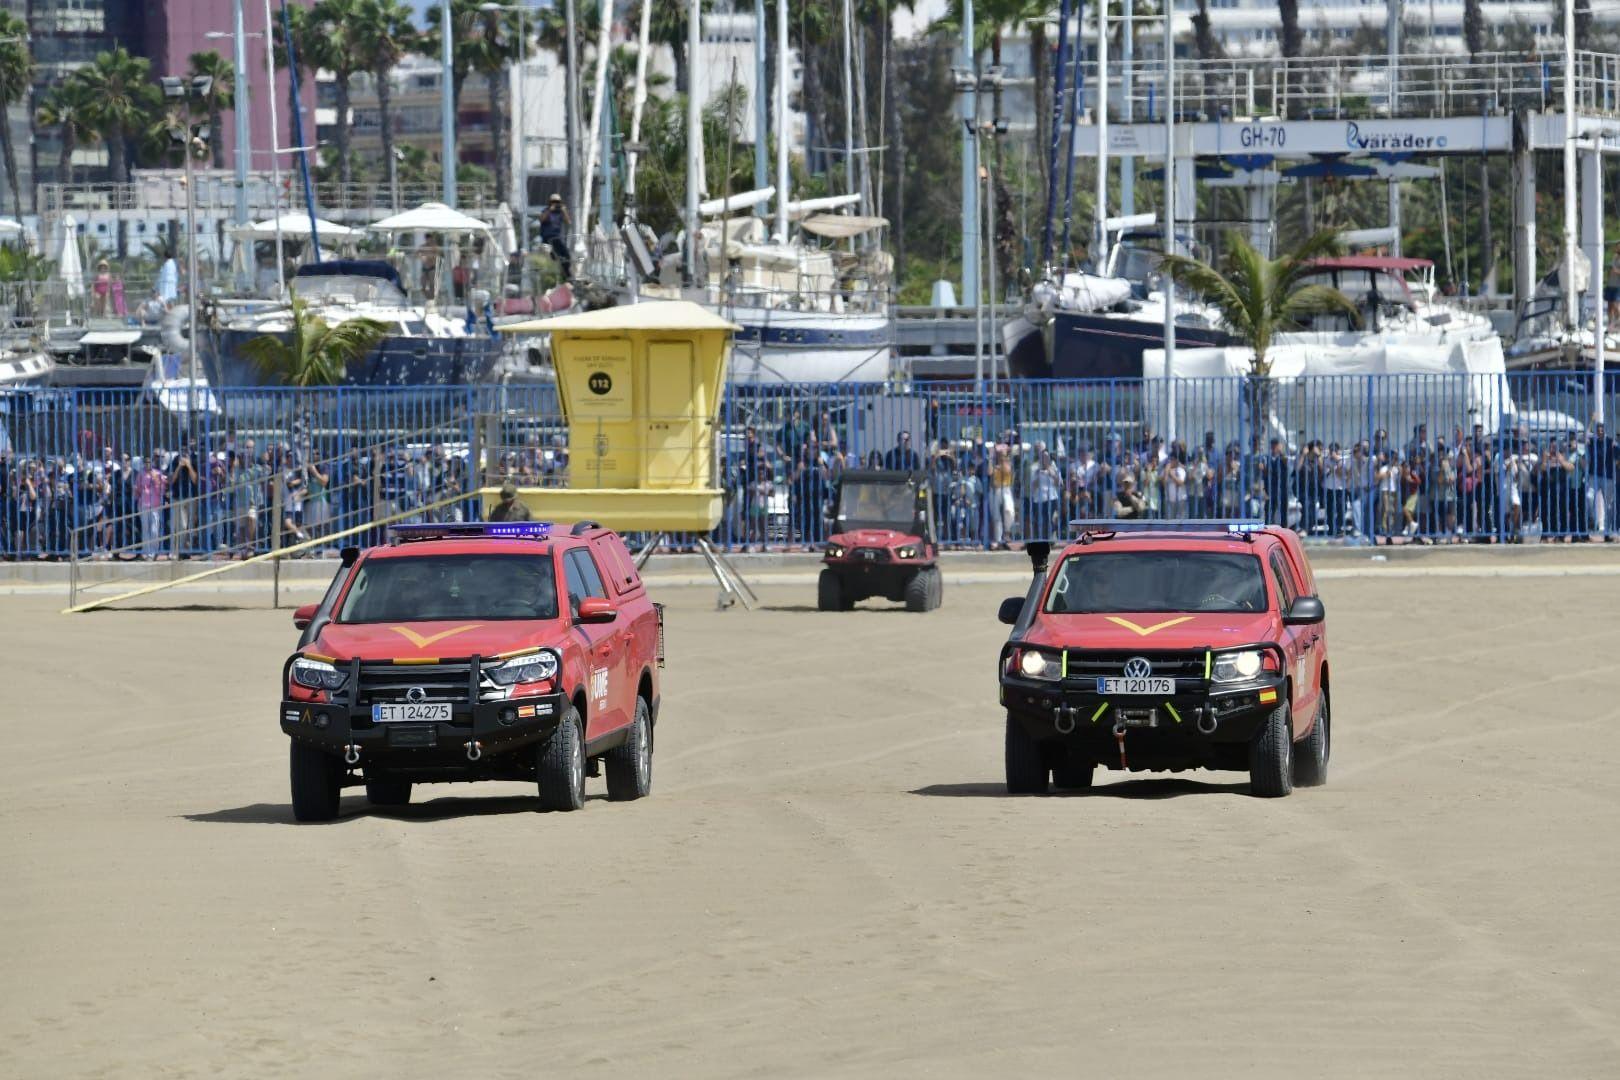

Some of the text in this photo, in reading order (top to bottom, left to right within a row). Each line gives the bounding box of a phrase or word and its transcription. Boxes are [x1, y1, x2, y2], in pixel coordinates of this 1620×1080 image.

[1240, 126, 1287, 147] GH-70
[1357, 134, 1448, 149] varadero
[591, 378, 610, 389] 112
[1124, 679, 1170, 693] 120176
[400, 705, 449, 719] 124275
